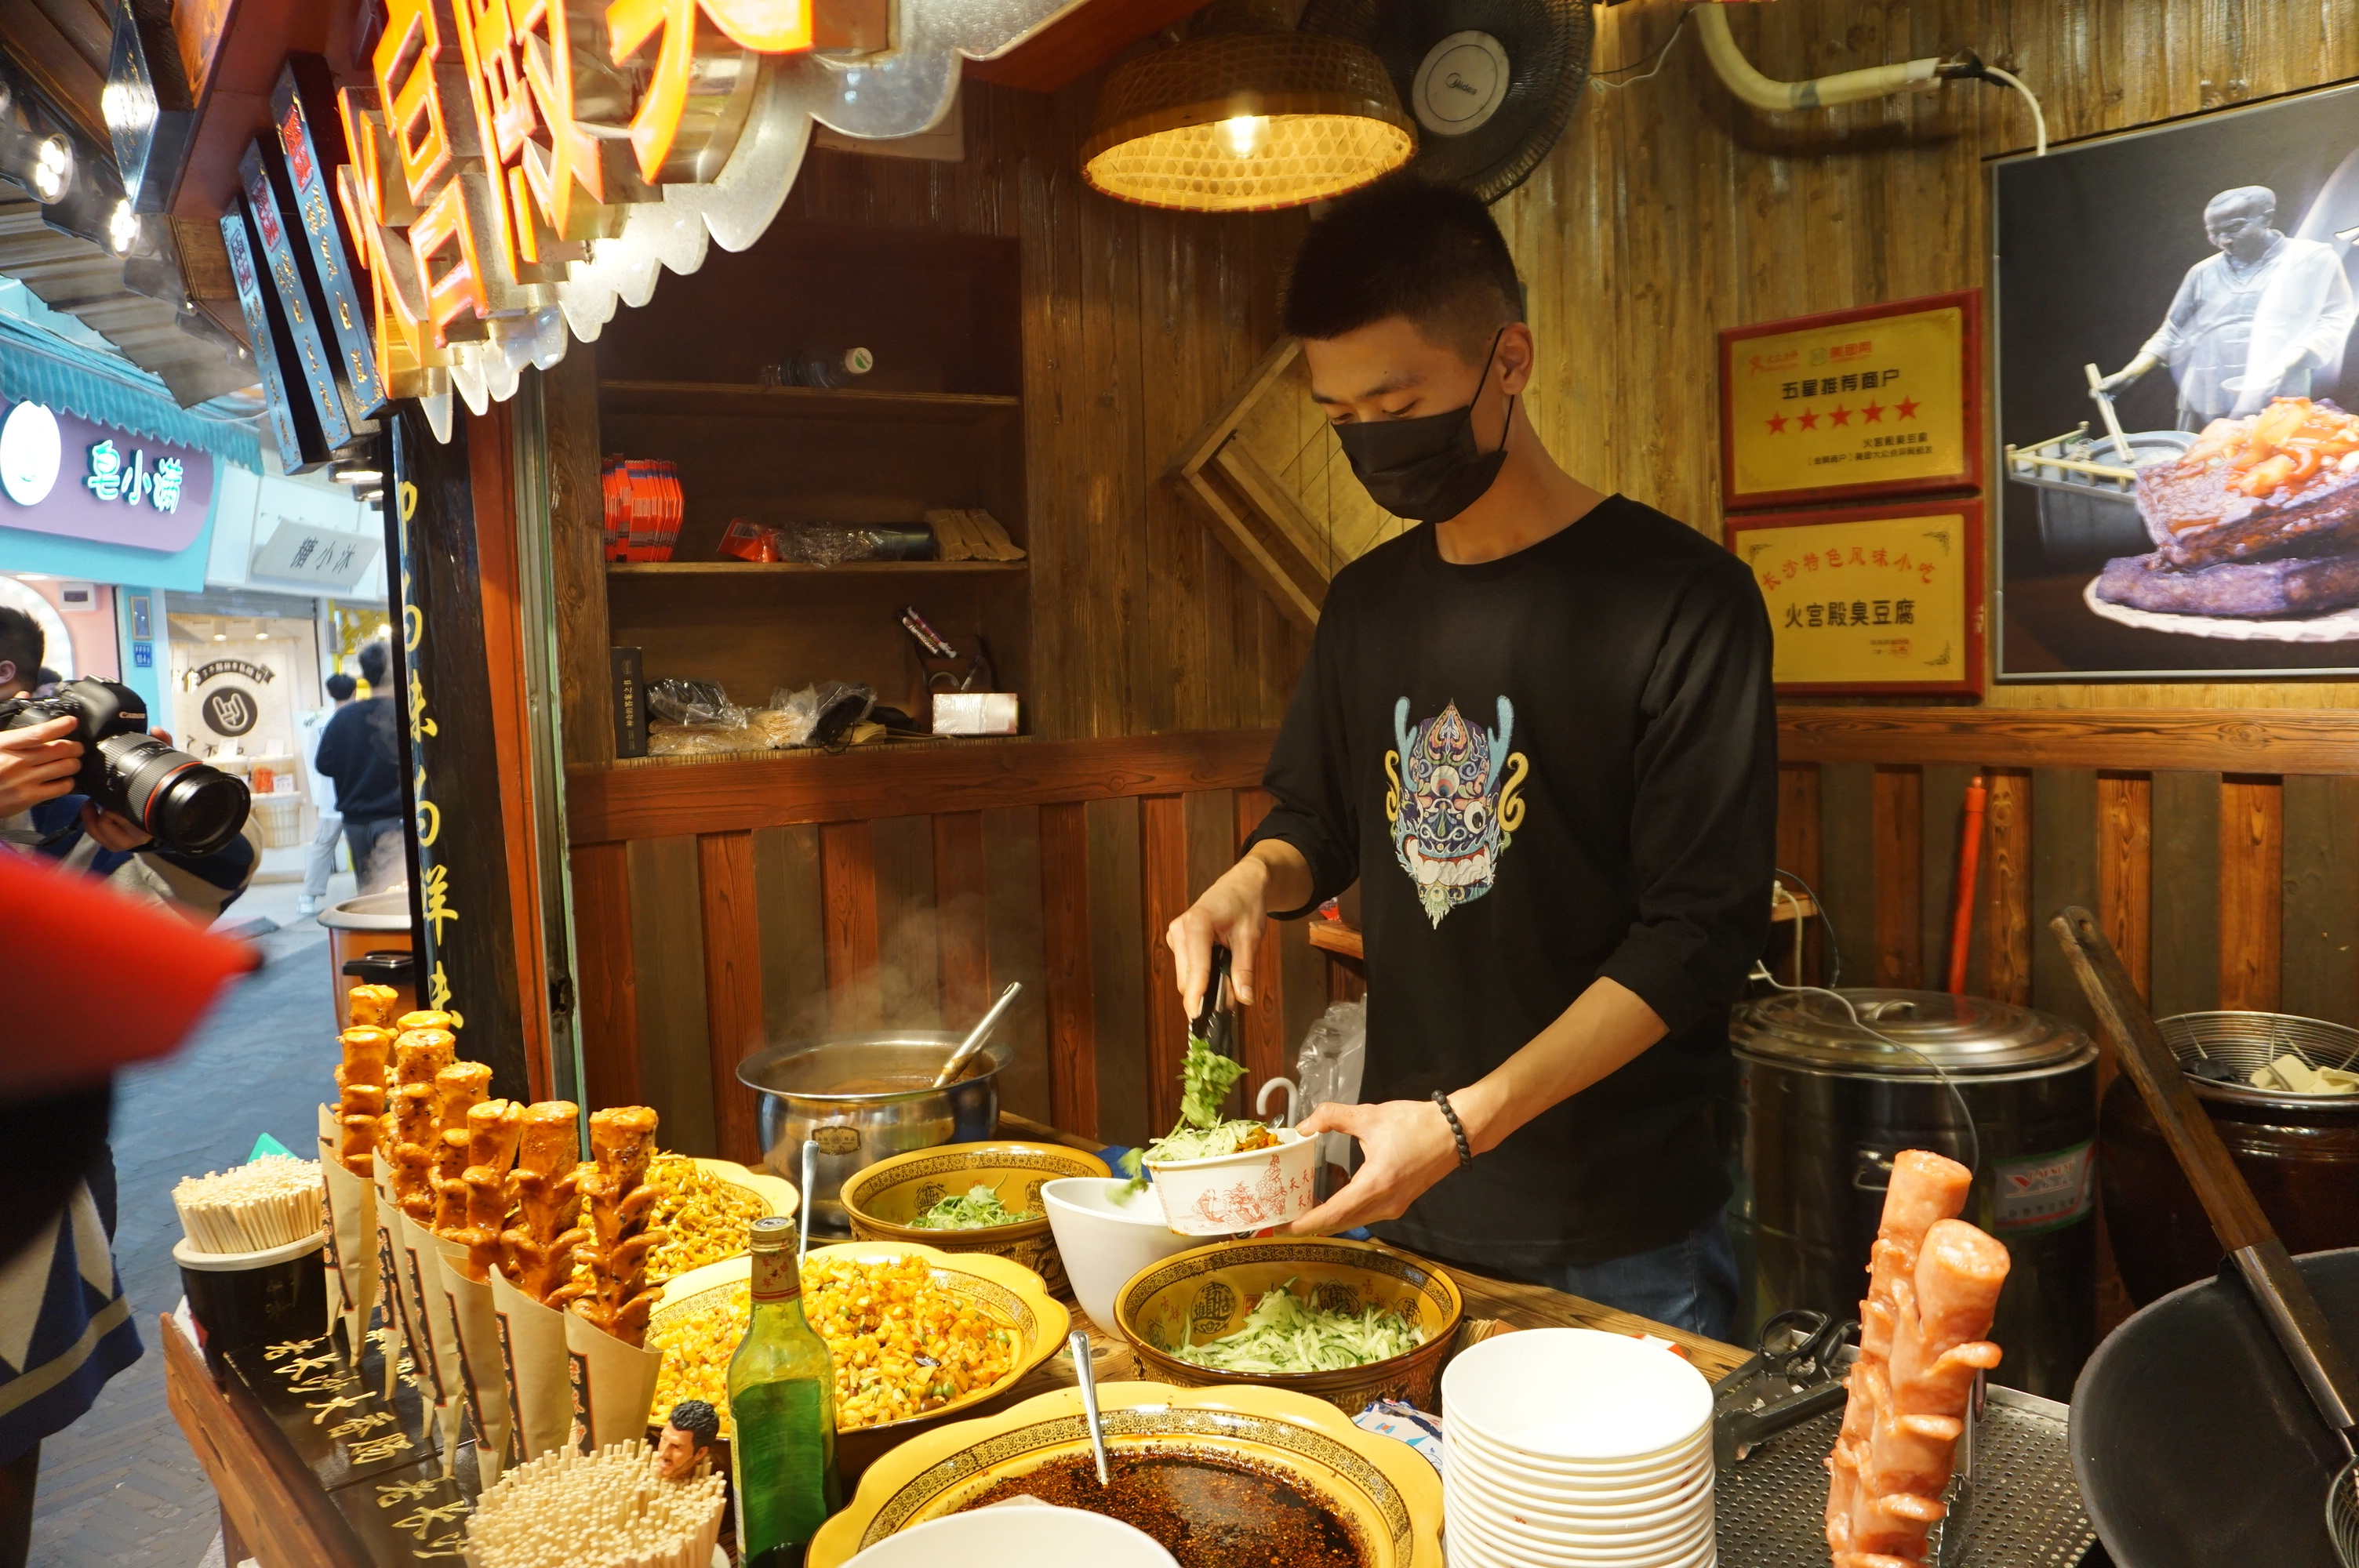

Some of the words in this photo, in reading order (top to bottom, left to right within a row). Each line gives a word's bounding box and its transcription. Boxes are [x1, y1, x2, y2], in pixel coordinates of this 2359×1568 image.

[1781, 368, 1901, 401] 五星推荐商户
[1863, 431, 1929, 449] 火宫殿臭豆腐
[87, 438, 184, 515] 皂小满
[289, 535, 358, 575] 糖小沐
[1762, 546, 1936, 591] 长沙特色风味小吃
[1785, 597, 1916, 628] 火宫殿臭豆腐
[119, 710, 147, 720] Canon
[263, 1334, 414, 1465] 老长沙大香肠
